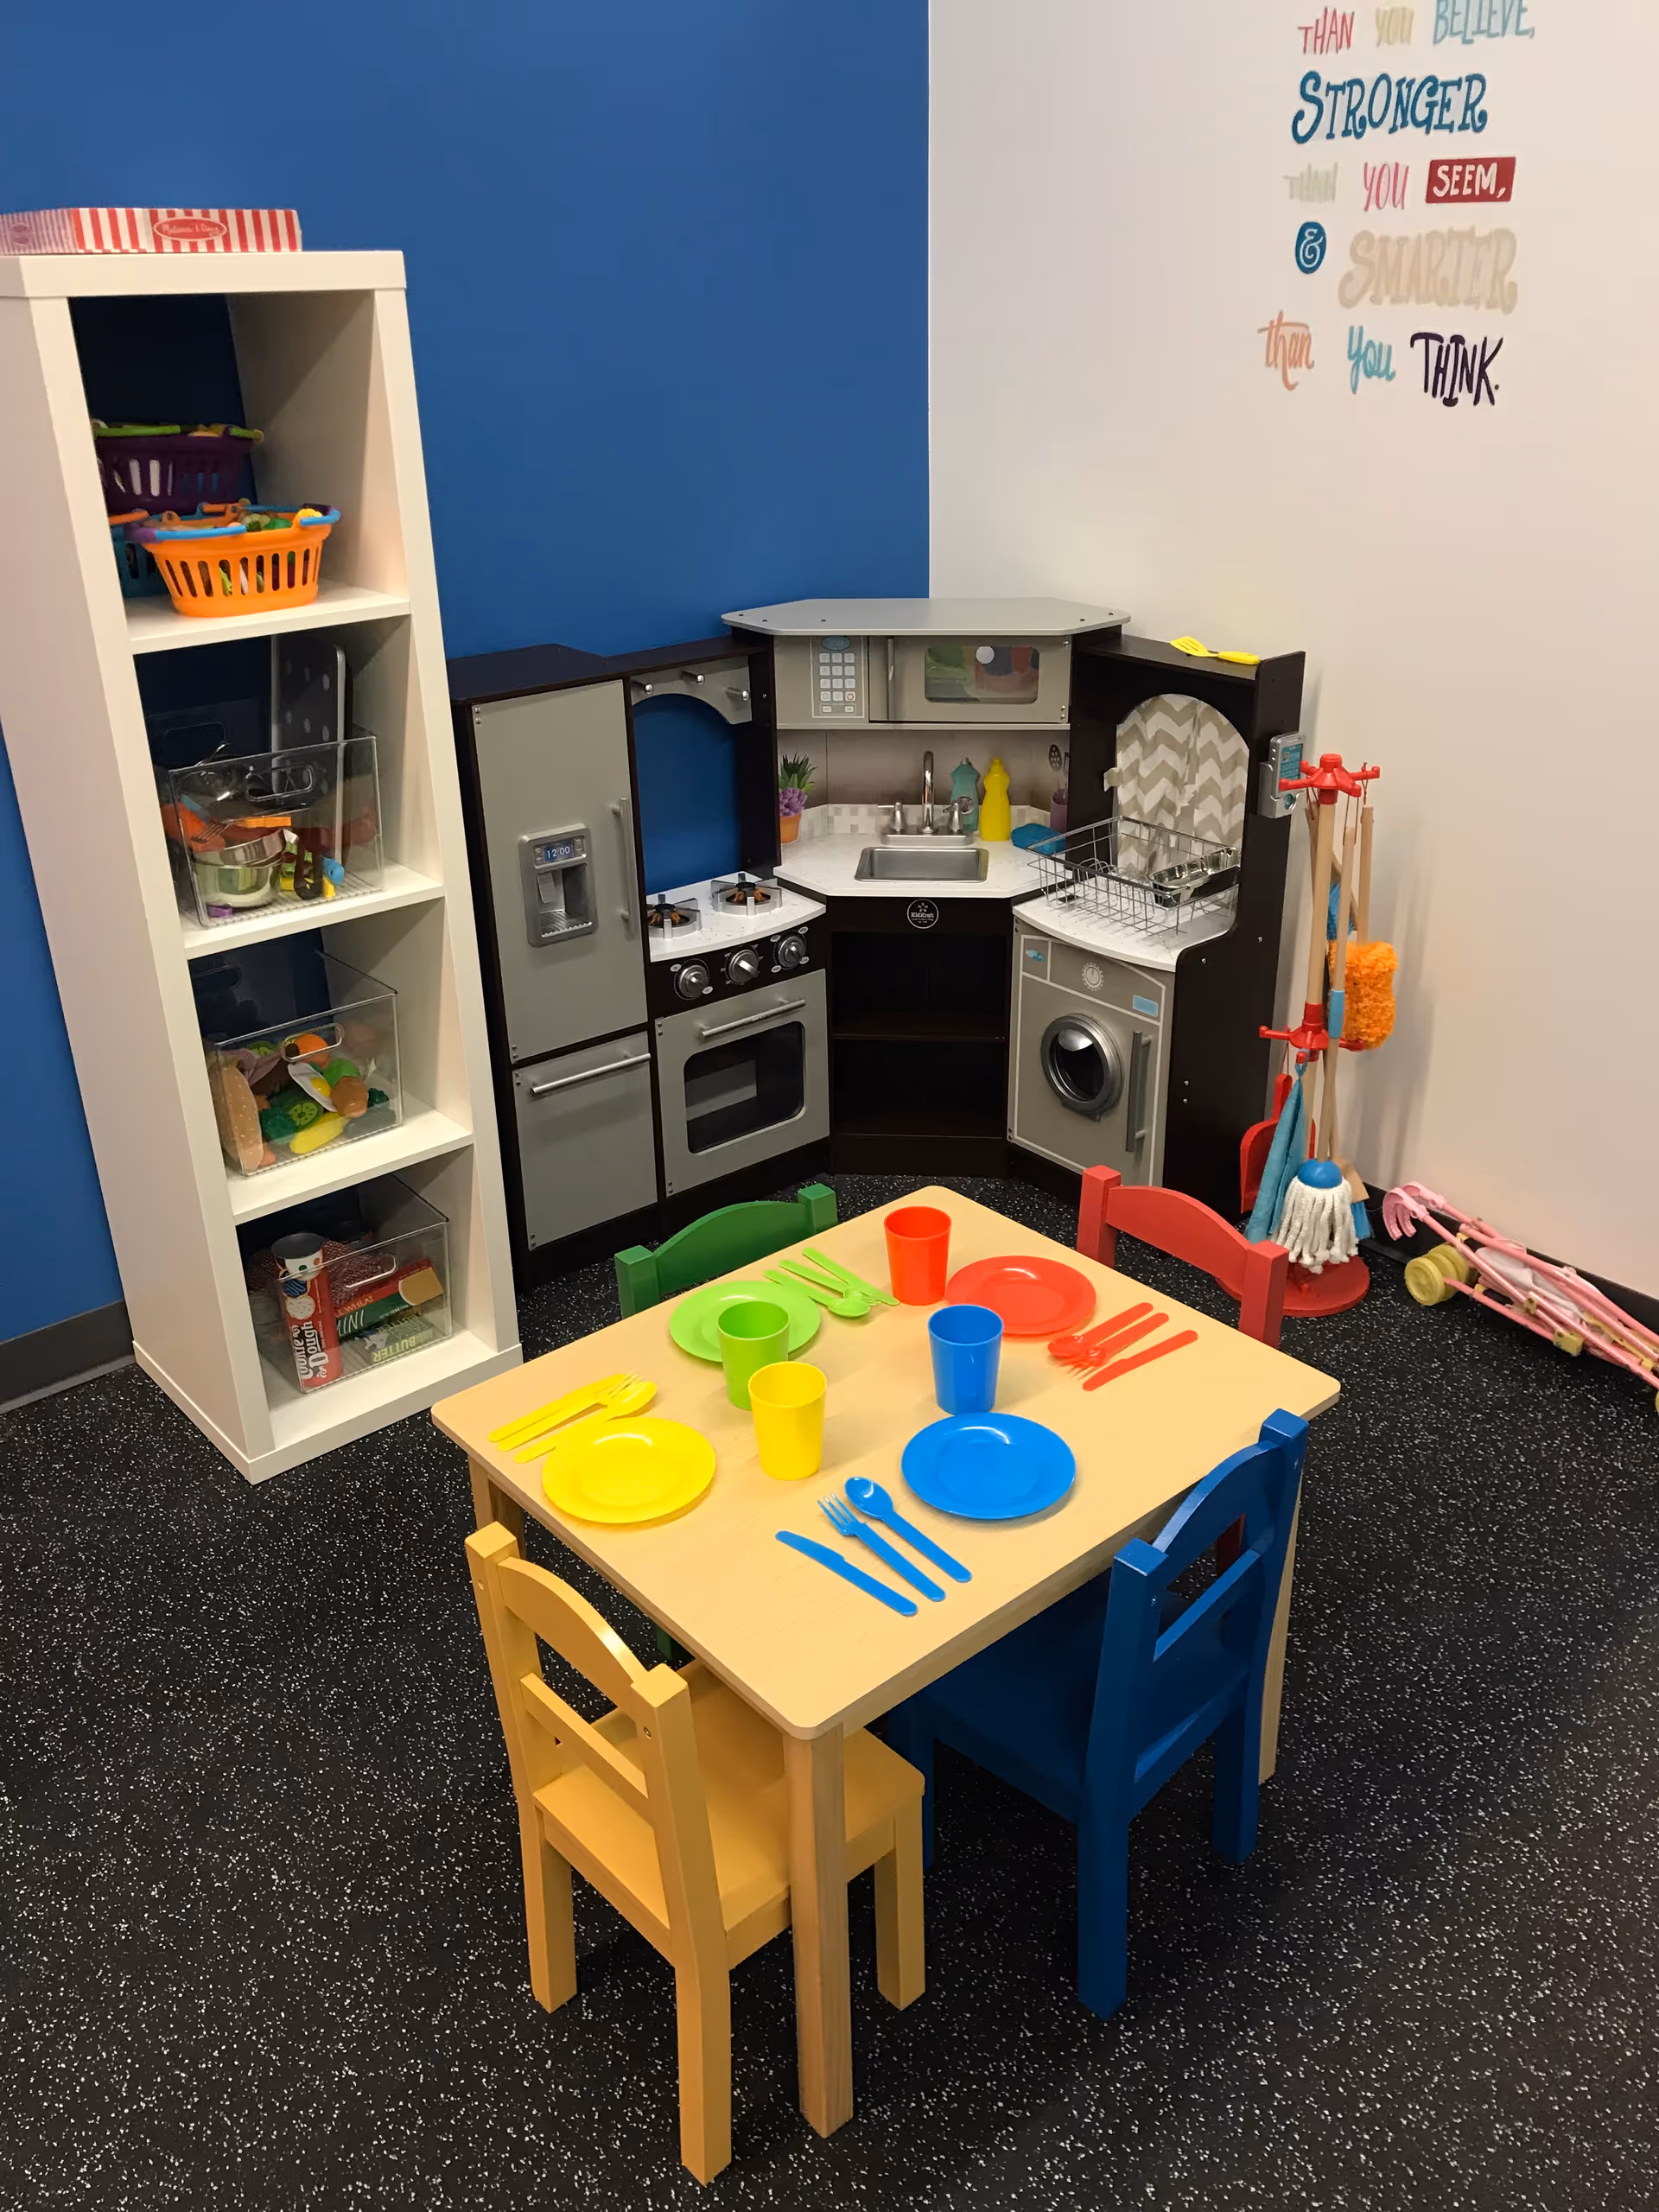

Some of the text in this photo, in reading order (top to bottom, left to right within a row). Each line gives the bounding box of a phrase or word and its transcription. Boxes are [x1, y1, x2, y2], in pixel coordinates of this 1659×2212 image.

[1298, 7, 1354, 54] THAN
[1376, 7, 1414, 48] YOU
[1292, 70, 1488, 144] STRONGER
[1363, 162, 1409, 212] YOU
[1433, 162, 1507, 200] SEEM,
[1298, 225, 1518, 315] & SMARTER
[1257, 310, 1315, 391] than
[1410, 332, 1504, 407] THINK.
[301, 1320, 329, 1368] Dough
